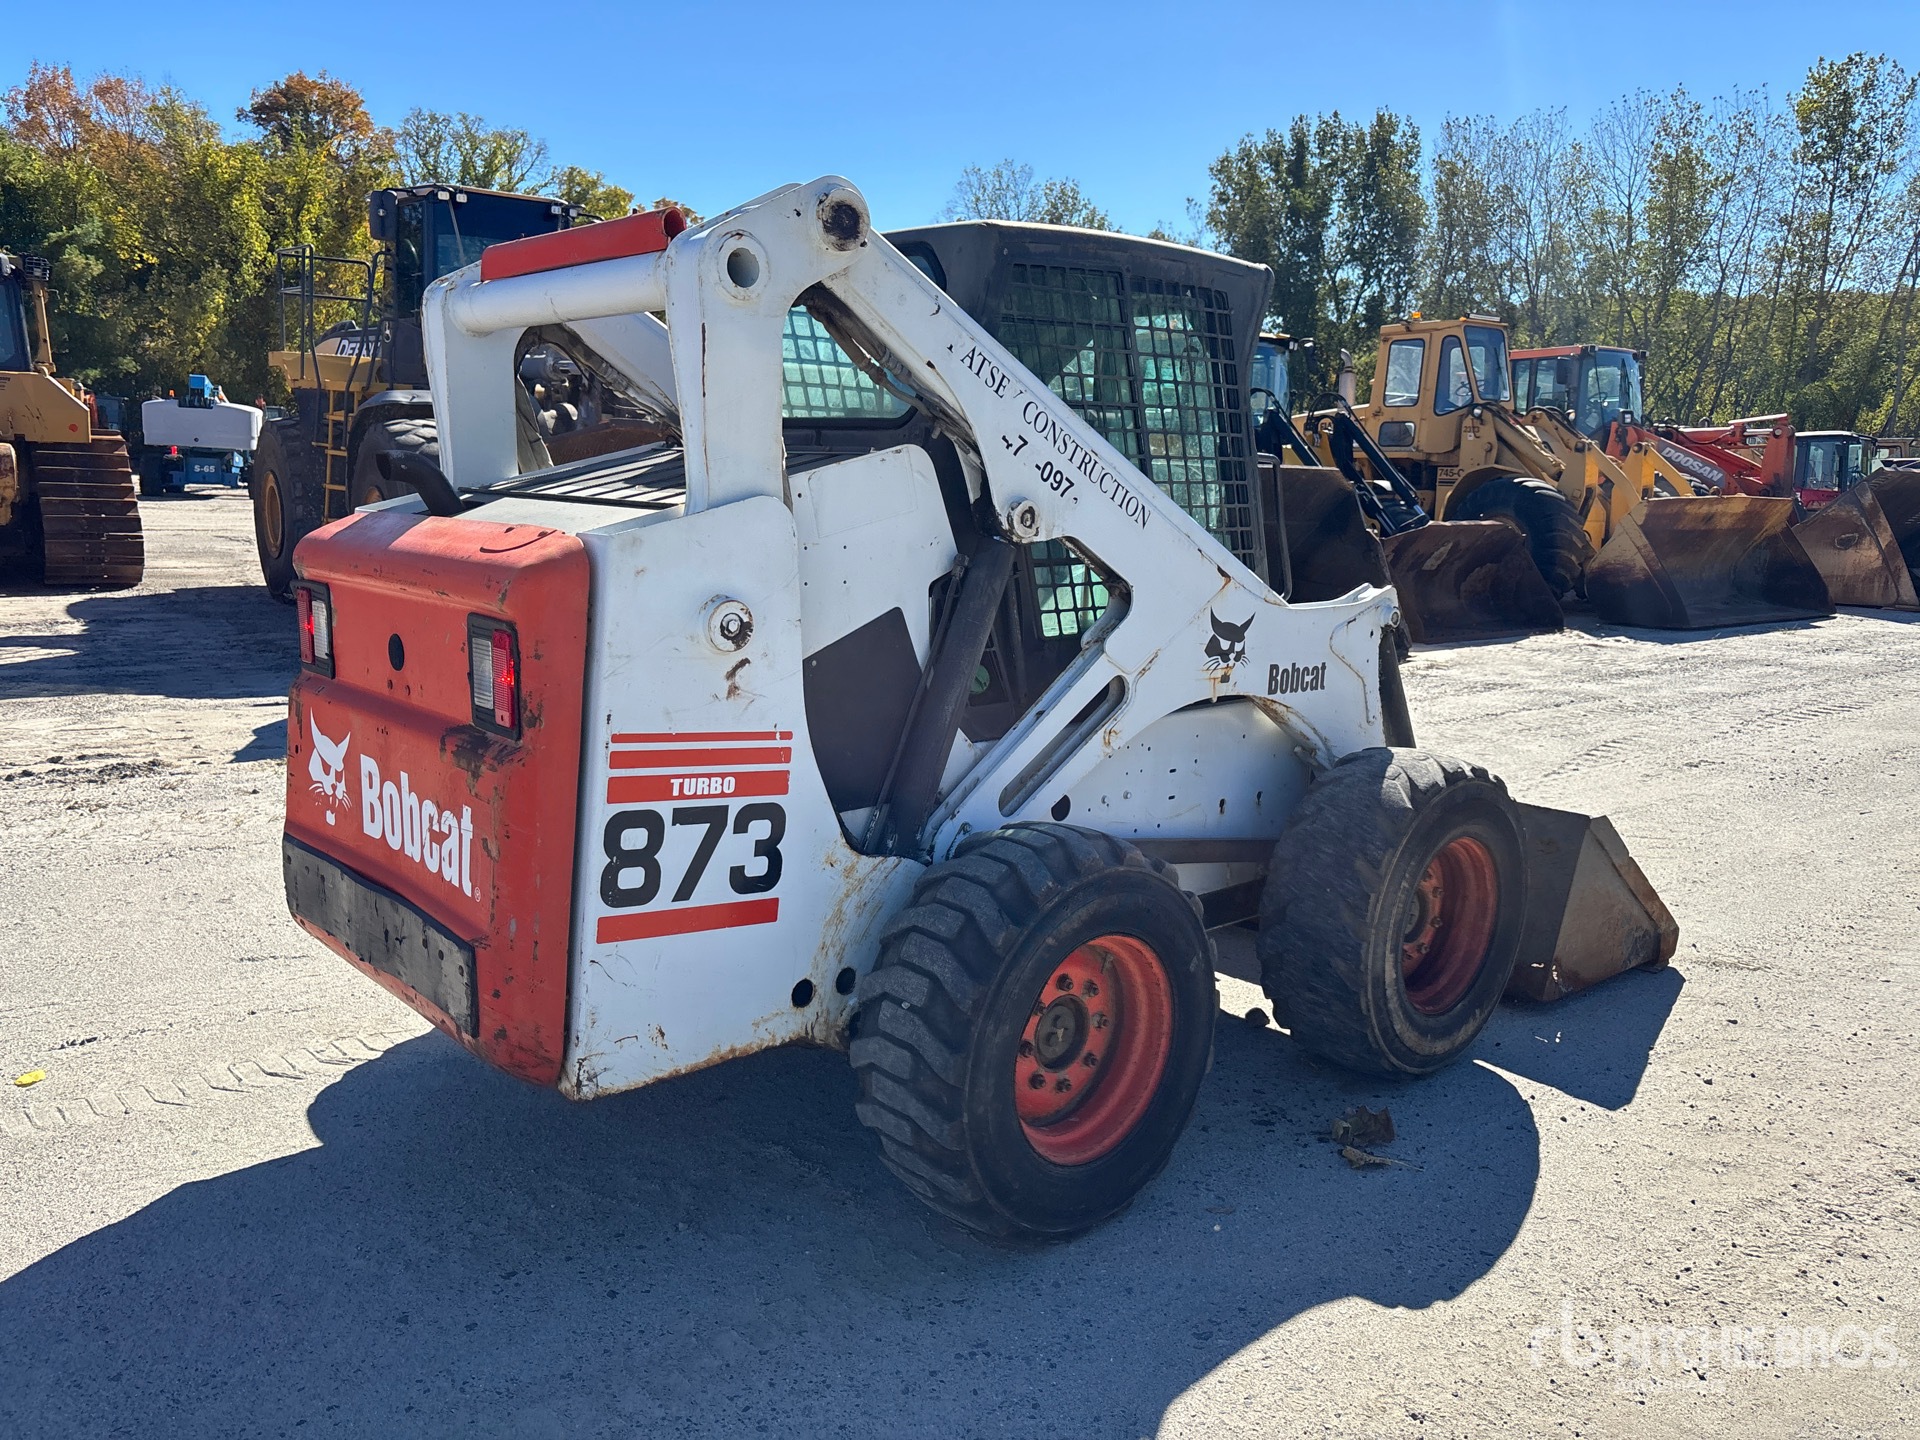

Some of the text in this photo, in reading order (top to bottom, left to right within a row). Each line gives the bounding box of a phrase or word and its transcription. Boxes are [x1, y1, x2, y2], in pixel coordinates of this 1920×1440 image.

[946, 344, 1151, 529] ATSE CONSTRUCTION
[193, 464, 216, 473] S-65
[1438, 468, 1465, 478] 745-C
[1661, 446, 1723, 481] DOOSAN
[1267, 661, 1327, 695] Bobcat
[670, 776, 736, 797] TURBO
[359, 753, 474, 898] Bobcat
[599, 802, 787, 909] 873
